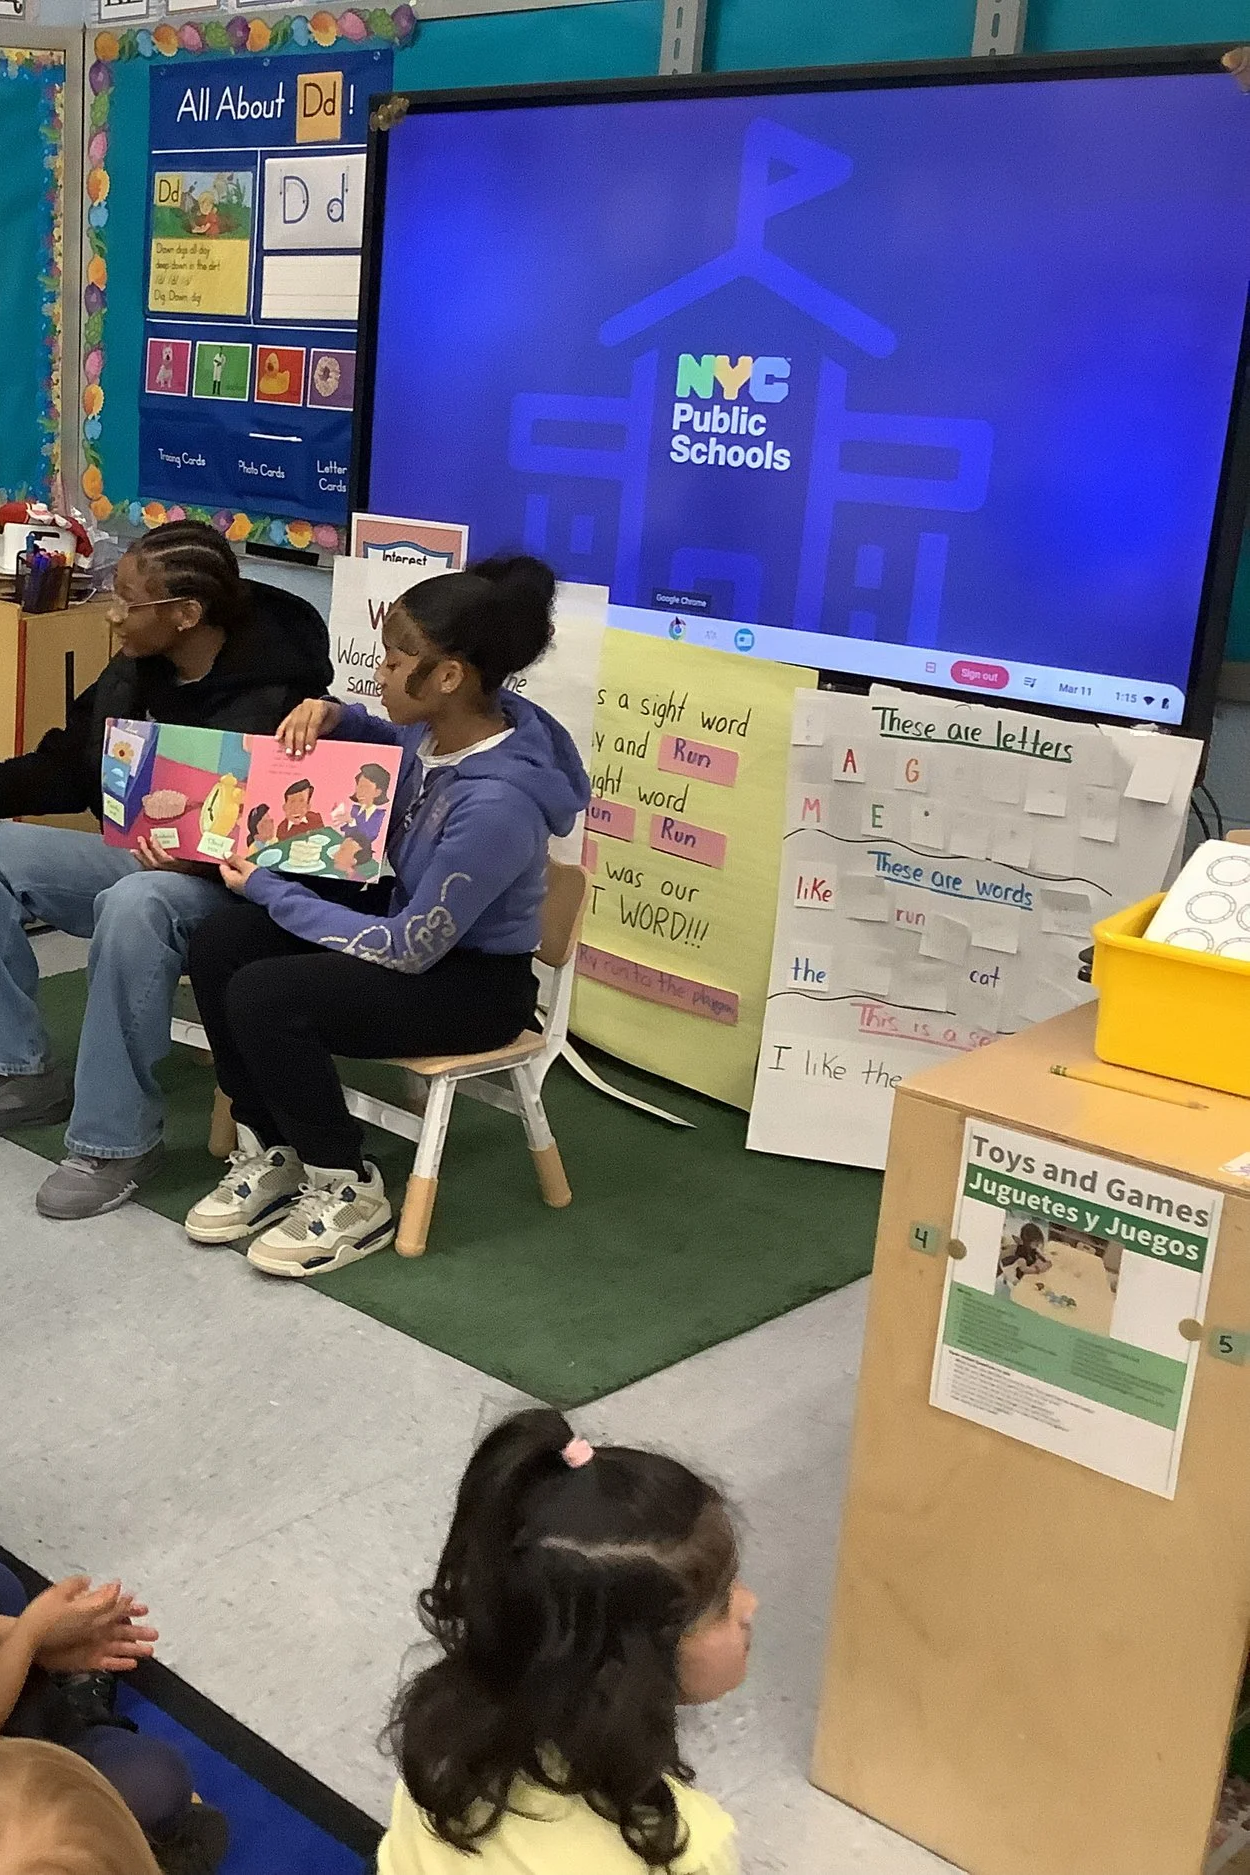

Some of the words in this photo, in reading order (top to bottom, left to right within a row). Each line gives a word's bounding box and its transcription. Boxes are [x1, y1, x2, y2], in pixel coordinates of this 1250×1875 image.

[176, 87, 210, 122] All
[215, 82, 285, 121] About
[303, 81, 337, 118] Dd
[158, 178, 180, 203] Dd
[282, 175, 310, 224] D
[326, 172, 345, 223] d
[676, 353, 791, 403] NYC
[672, 402, 767, 436] Public
[158, 448, 181, 468] Tracing
[181, 452, 206, 467] Cards
[238, 460, 258, 475] Photo
[260, 464, 285, 479] Cards
[316, 460, 347, 475] Letter
[670, 434, 791, 471] Schools
[318, 478, 347, 493] Cards
[382, 549, 428, 566] Interest
[656, 593, 680, 605] Google
[680, 596, 707, 608] Chrome
[337, 635, 381, 670] Words
[348, 675, 382, 695] same
[960, 667, 981, 681] Sign
[982, 672, 999, 682] out
[1058, 682, 1078, 694] Mar
[1080, 685, 1092, 696] 11
[1115, 691, 1137, 703] 1:15
[618, 693, 629, 710] a
[640, 691, 688, 728] sight
[701, 708, 751, 738] word
[592, 731, 605, 752] y
[614, 730, 650, 759] and
[673, 738, 711, 769] Run
[871, 706, 936, 739] These
[947, 722, 983, 742] are
[996, 720, 1074, 761] letters
[842, 748, 857, 774] A
[905, 757, 919, 783] G
[638, 784, 689, 813] word
[801, 797, 821, 822] M
[871, 804, 884, 829] E
[586, 806, 611, 823] un
[661, 818, 697, 848] Run
[606, 860, 644, 888] was
[661, 877, 700, 904] our
[868, 851, 923, 883] These
[930, 870, 963, 891] are
[976, 877, 1034, 907] words
[796, 876, 833, 903] like
[895, 908, 926, 927] run
[620, 893, 710, 949] WORD!!!
[657, 971, 686, 997] the
[791, 956, 827, 984] the
[969, 966, 1000, 989] cat
[850, 1002, 898, 1032] This
[913, 1023, 930, 1037] is
[943, 1029, 956, 1042] a
[768, 1045, 792, 1070] I
[805, 1050, 847, 1080] like
[862, 1059, 903, 1088] the
[972, 1135, 1036, 1175] Toys
[1043, 1159, 1098, 1194] and
[1107, 1177, 1210, 1228] Games
[968, 1171, 1078, 1223] Juguetes
[1082, 1212, 1100, 1233] y
[1105, 1216, 1200, 1261] Juegos
[914, 1227, 929, 1249] 4
[1219, 1334, 1234, 1355] 5
